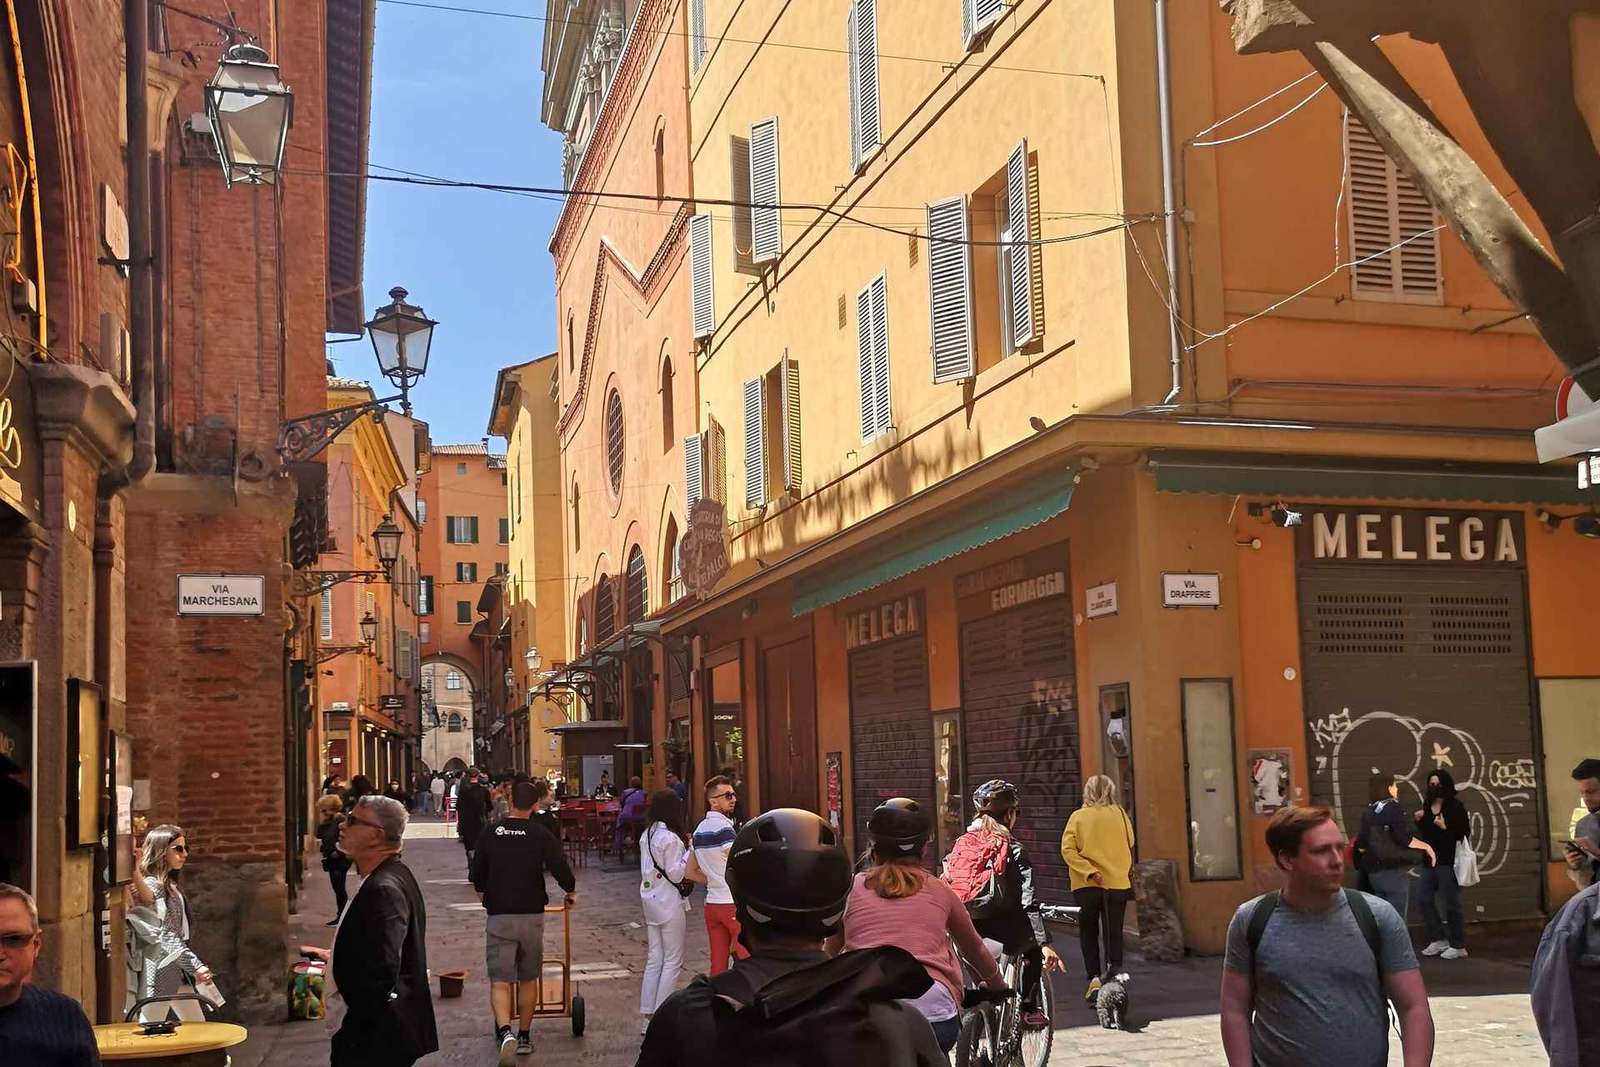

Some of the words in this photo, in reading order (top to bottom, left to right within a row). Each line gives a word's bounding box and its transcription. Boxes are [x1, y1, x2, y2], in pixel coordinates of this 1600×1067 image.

[1313, 512, 1518, 561] MELEGA
[212, 585, 229, 593] VIA
[1170, 590, 1211, 598] DRAPPERIE
[182, 596, 258, 606] MARCHESANA
[846, 597, 918, 649] MELEGA
